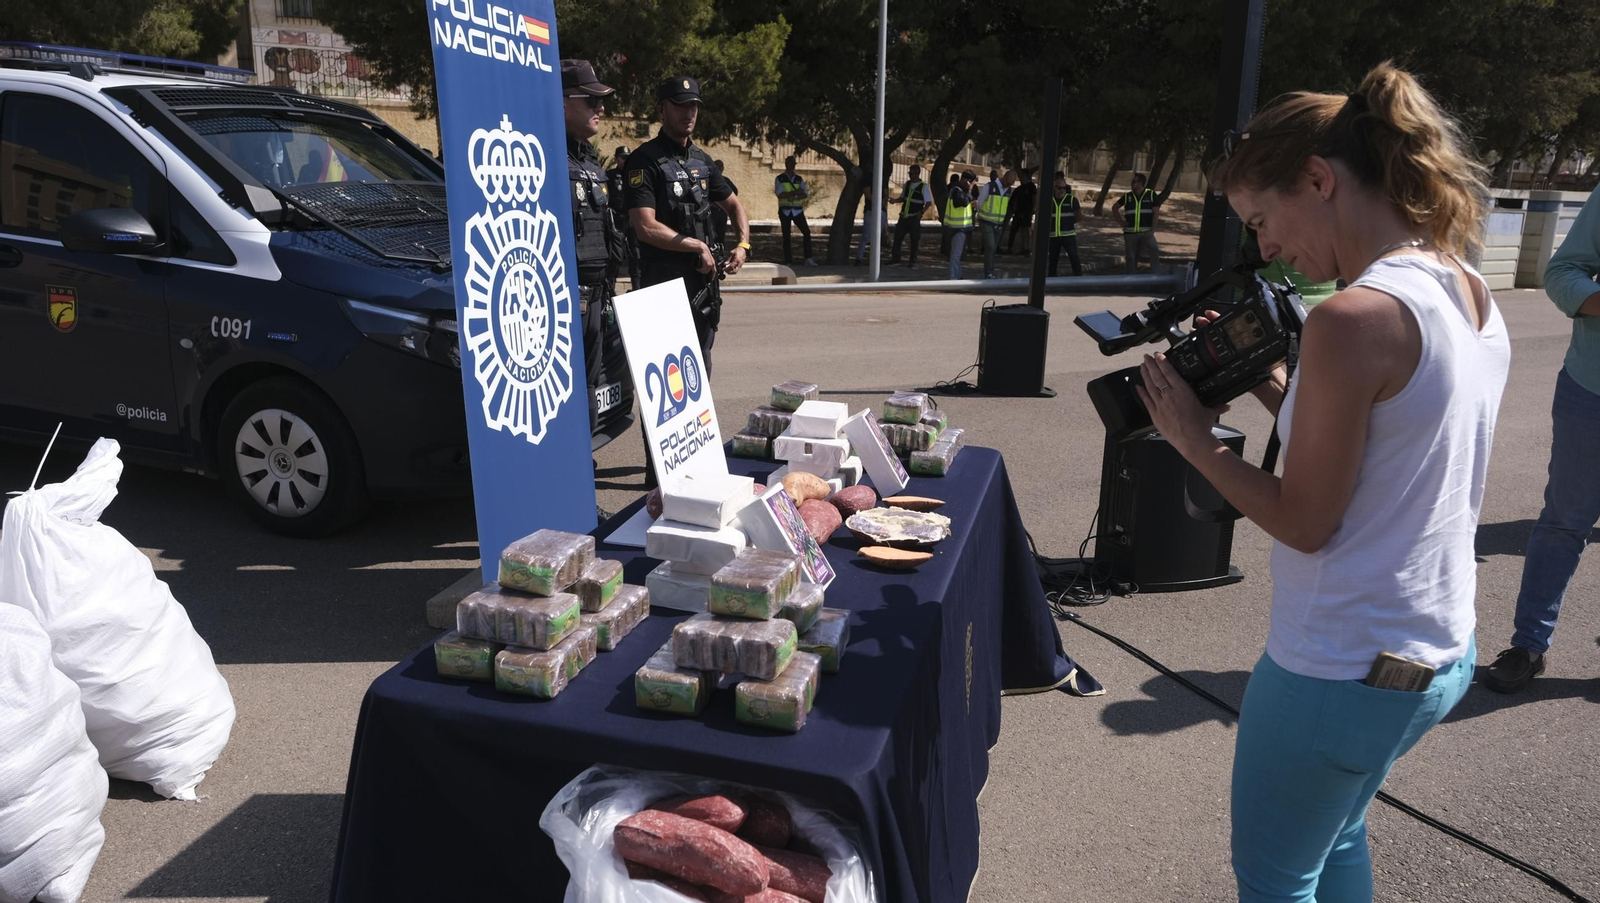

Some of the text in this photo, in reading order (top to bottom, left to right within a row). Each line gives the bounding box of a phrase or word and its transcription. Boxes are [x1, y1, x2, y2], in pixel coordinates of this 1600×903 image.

[434, 17, 553, 73] NACIONAL
[505, 347, 552, 382] NACIONAL
[644, 345, 702, 428] 200
[116, 403, 167, 422] @policia
[664, 428, 715, 475] NACIONAL
